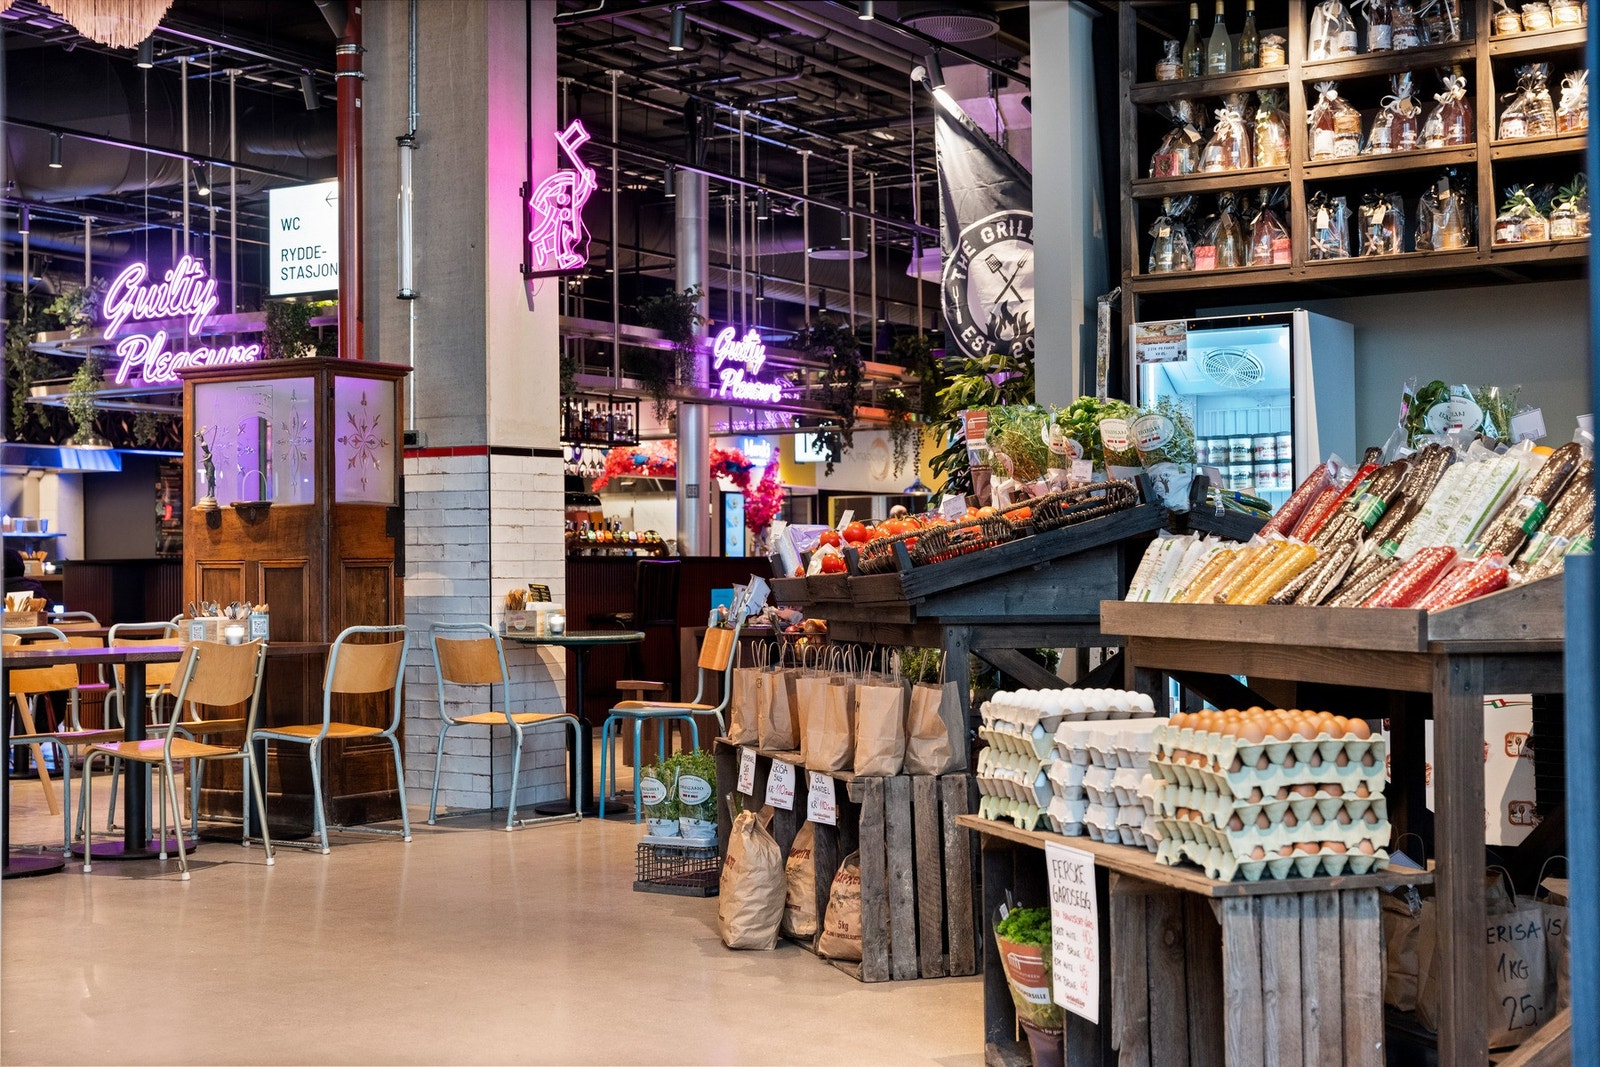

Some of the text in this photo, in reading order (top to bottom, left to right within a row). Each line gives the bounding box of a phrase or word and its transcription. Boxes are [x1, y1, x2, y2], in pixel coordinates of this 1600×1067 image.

[280, 217, 301, 231] WC
[281, 245, 327, 262] RYDDE-
[950, 219, 1034, 281] THE GRIL
[280, 262, 338, 281] STASJON
[103, 254, 220, 341] Guilty
[713, 326, 767, 376] Guilty
[1051, 859, 1086, 886] FERSKE
[837, 919, 849, 932] 5kg
[1487, 921, 1541, 944] ERISA
[1497, 952, 1529, 983] 1KG
